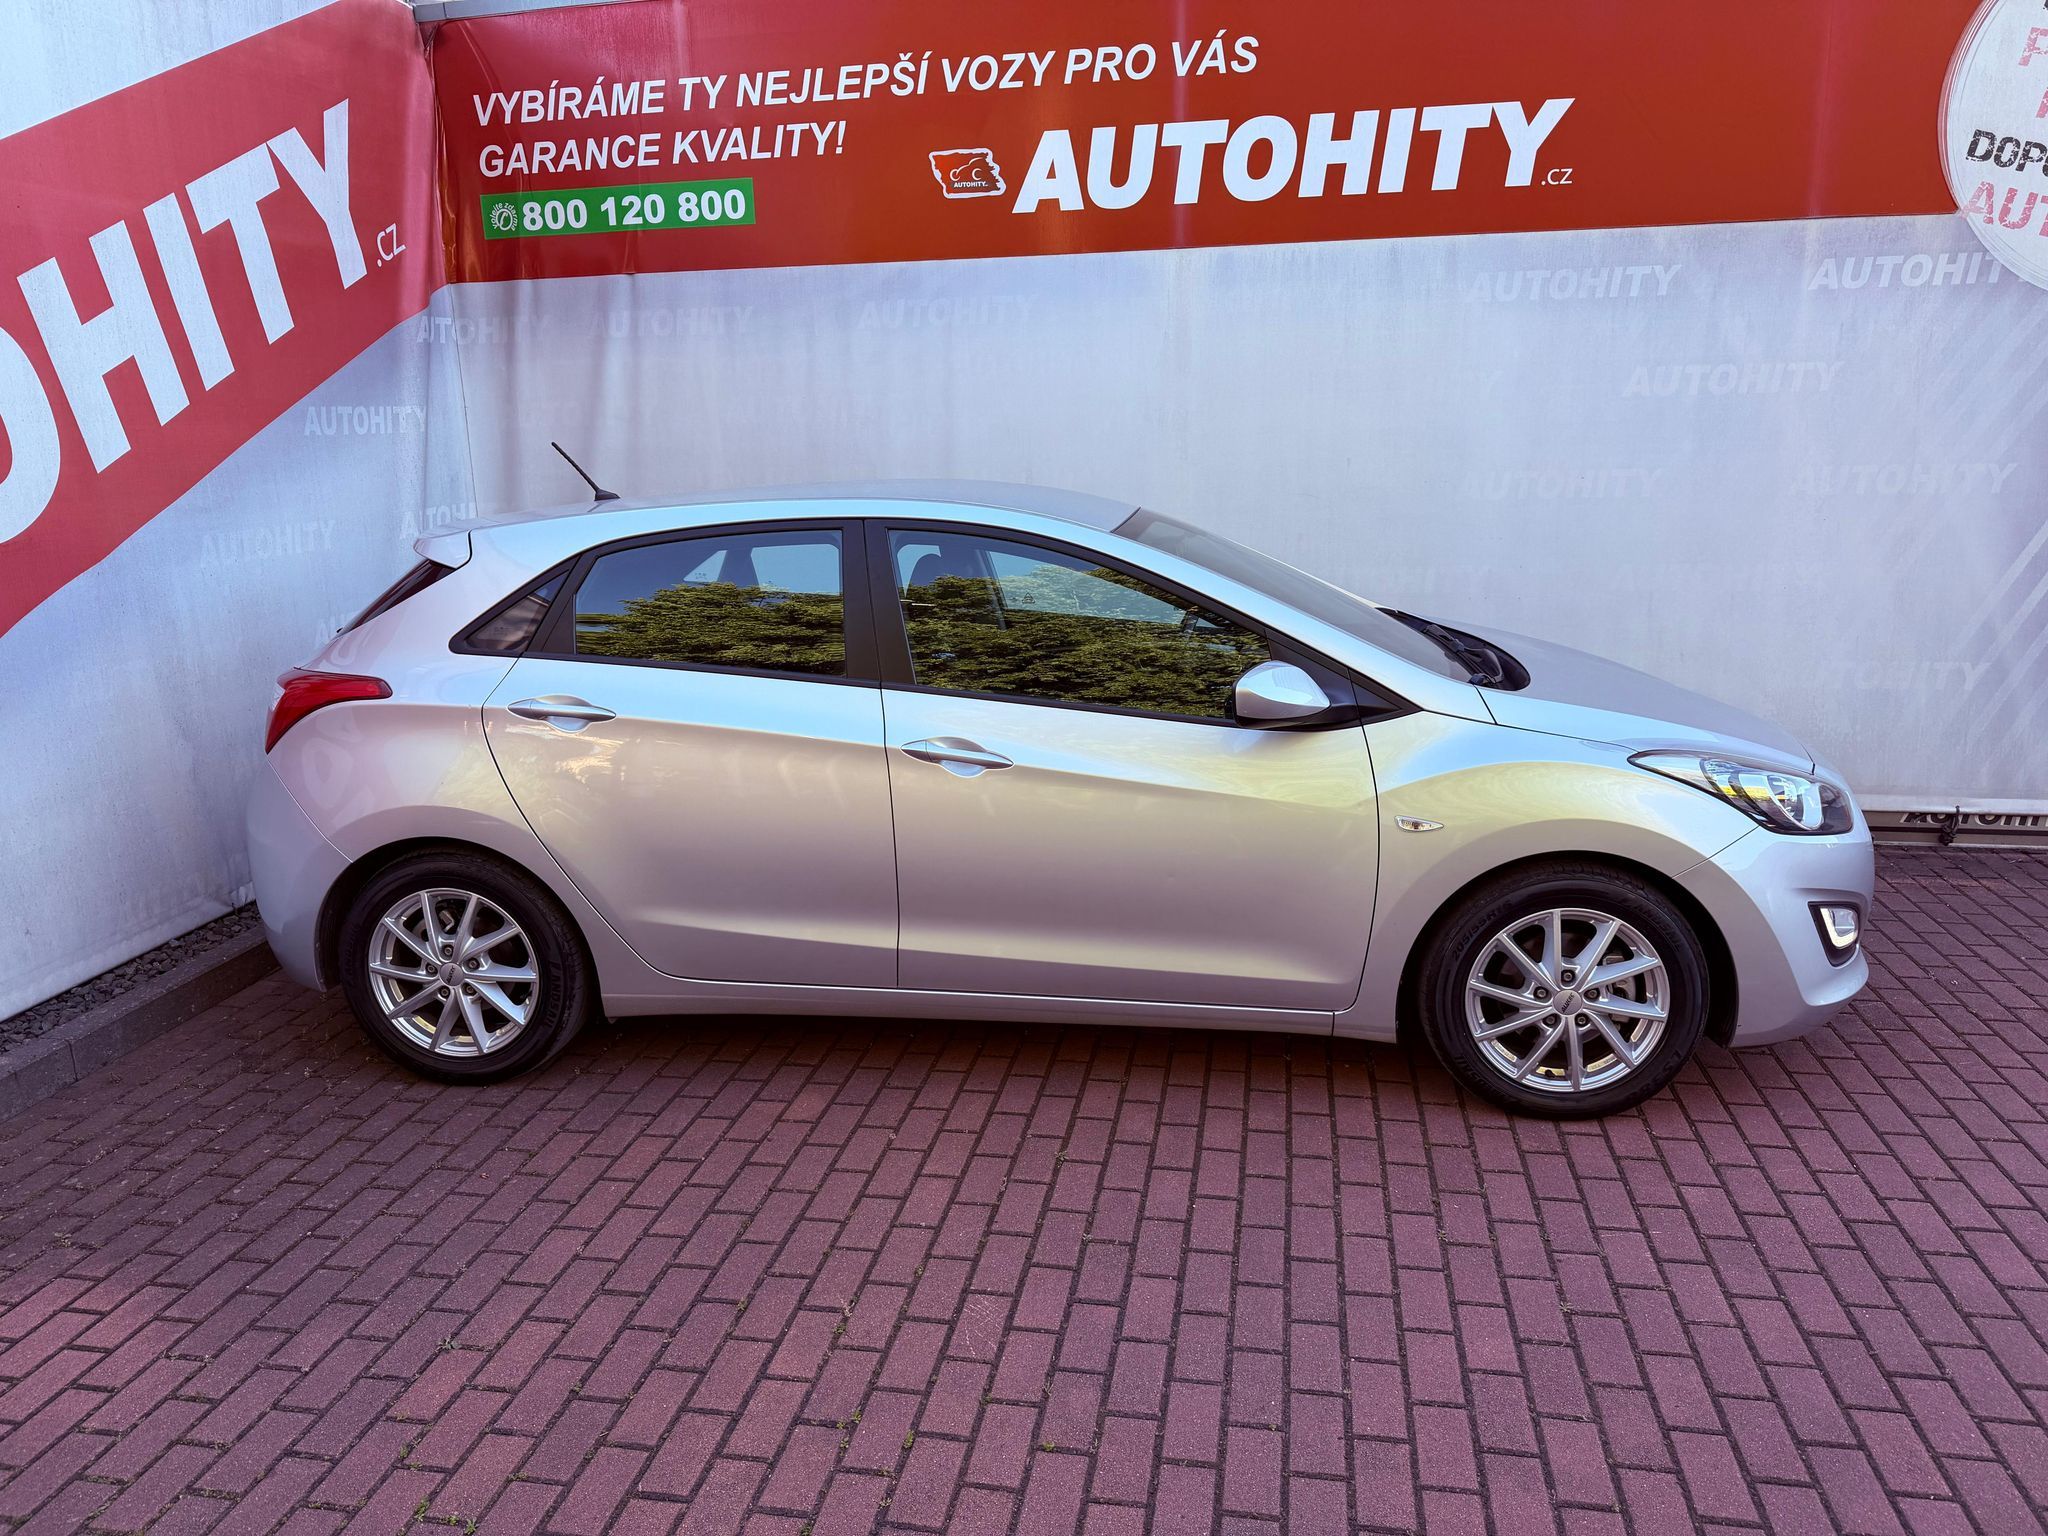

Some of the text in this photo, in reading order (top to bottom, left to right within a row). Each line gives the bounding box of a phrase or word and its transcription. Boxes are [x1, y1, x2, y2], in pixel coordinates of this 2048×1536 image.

[474, 29, 1259, 126] VYBÍRÁME TY NEJLEPŠÍ VOZY PRO VÁS
[479, 120, 847, 178] GARANCE KVALITY!
[1012, 97, 1575, 214] AUTOHITY
[1966, 129, 2048, 177] DOP
[522, 189, 746, 231] 800 120 800
[1472, 264, 1682, 302] AUTOHITY
[1807, 252, 2030, 291] AUTOHIT
[1622, 361, 1844, 398] AUTOHITY
[304, 405, 426, 437] AUTOHITY
